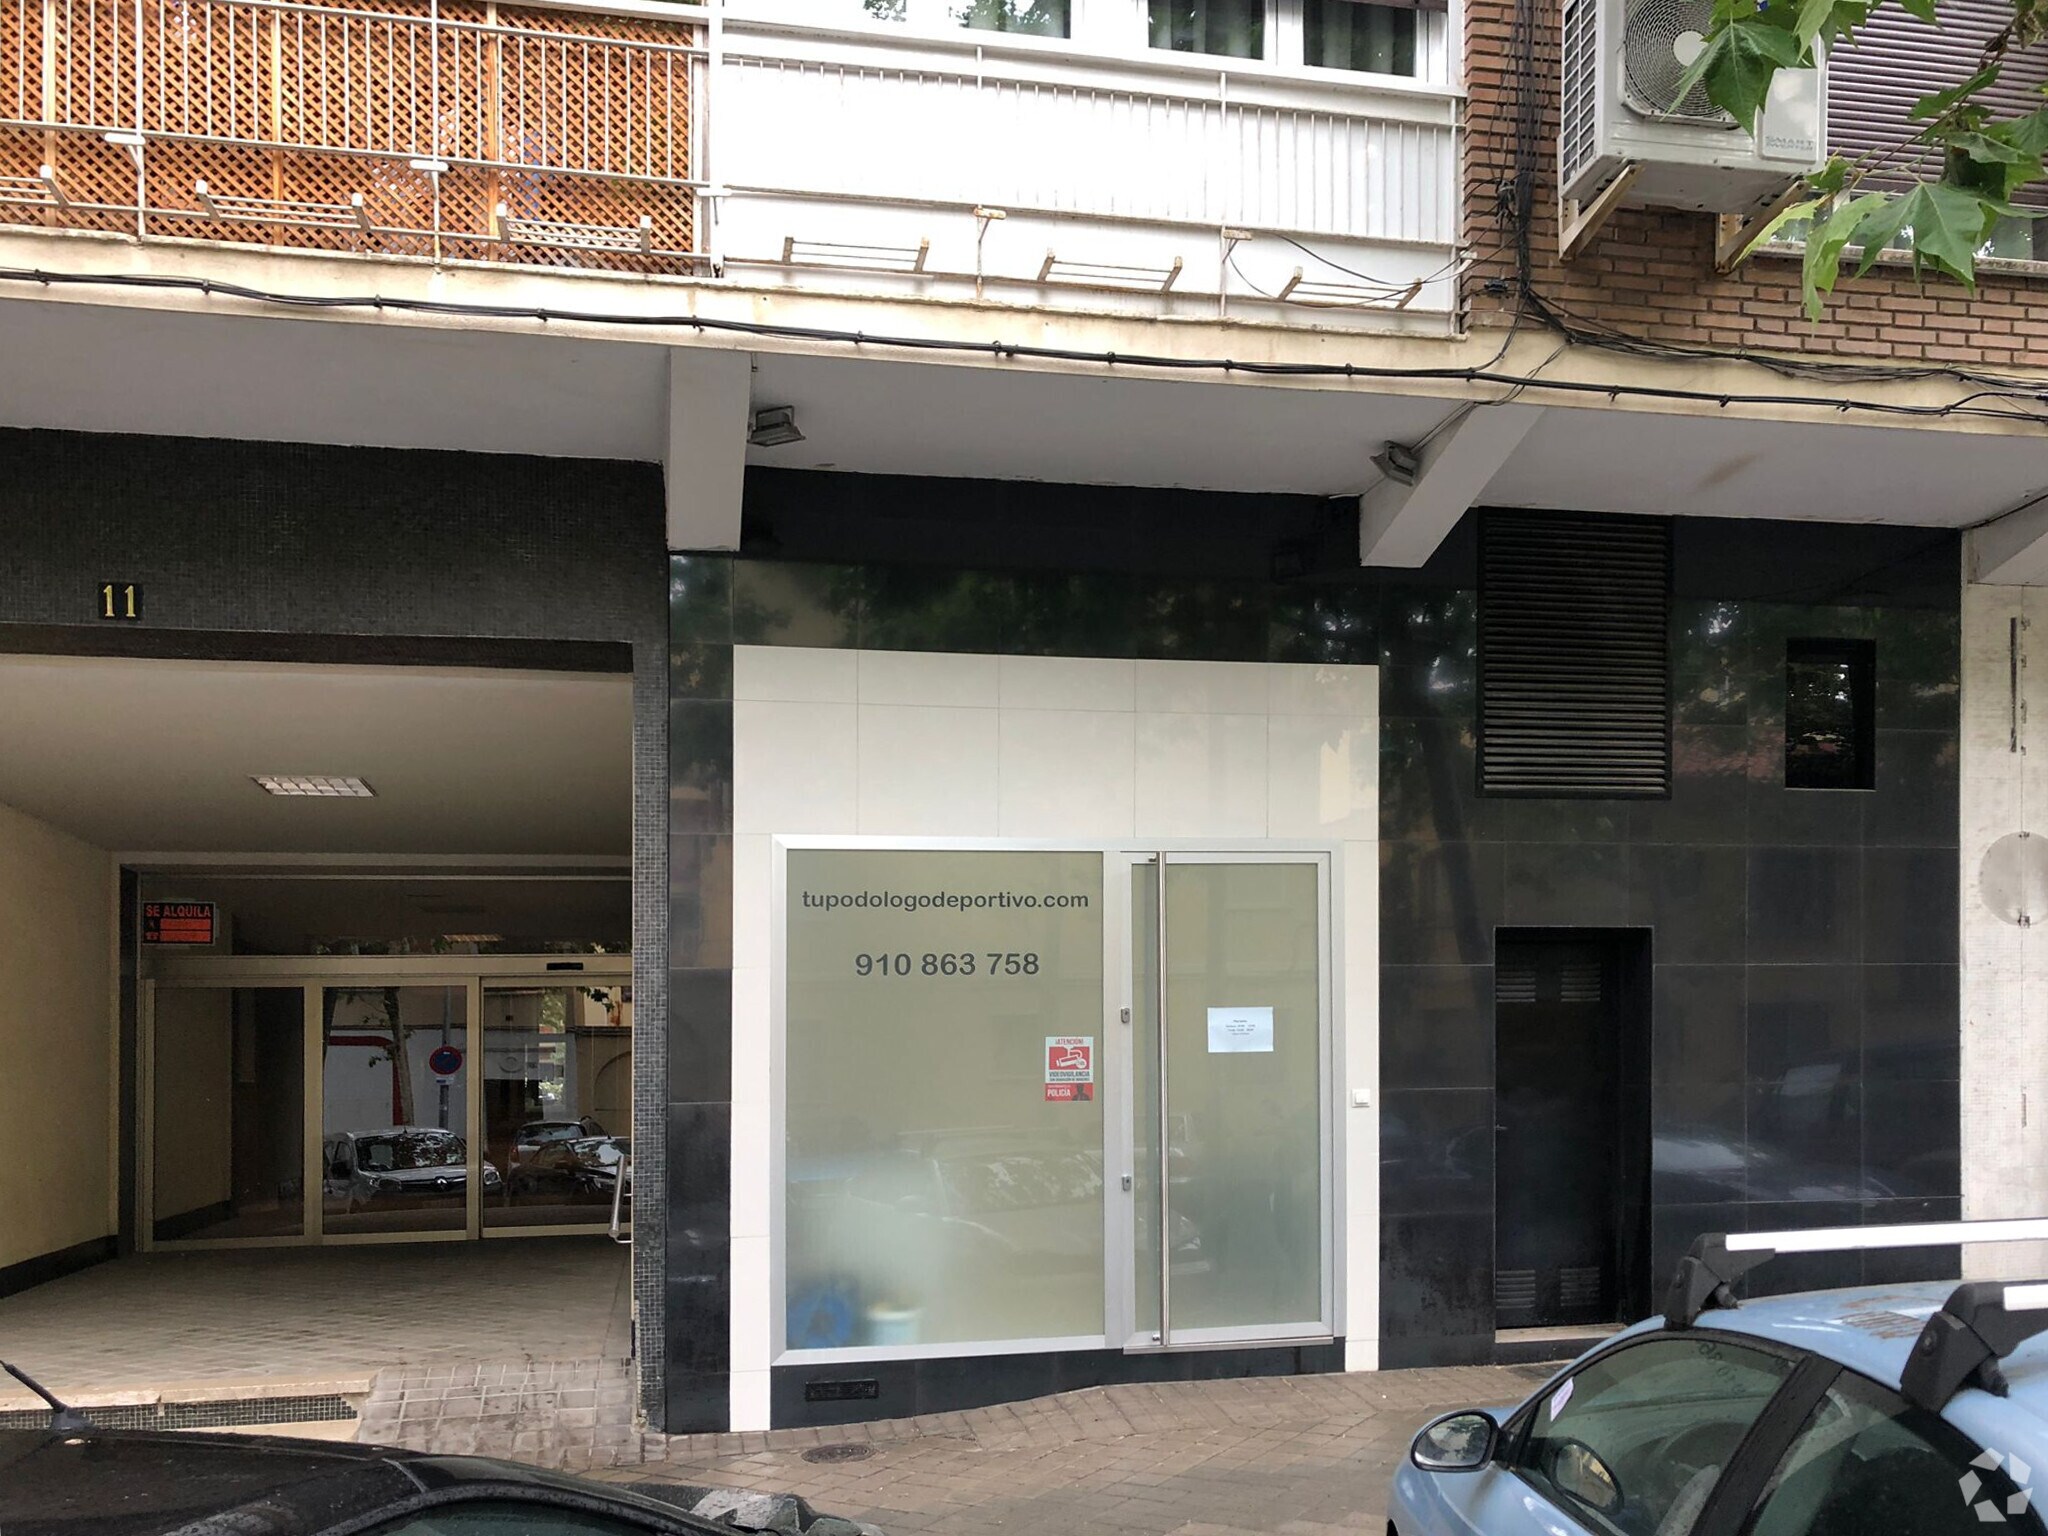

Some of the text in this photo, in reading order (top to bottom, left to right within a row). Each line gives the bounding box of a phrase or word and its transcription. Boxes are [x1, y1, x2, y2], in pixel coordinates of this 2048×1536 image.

[1766, 136, 1814, 146] SMART
[103, 585, 136, 617] 11
[146, 905, 211, 917] SE ALQUILA
[802, 890, 1089, 912] tupodologodeportivo.com
[855, 952, 1039, 976] 910 863 758
